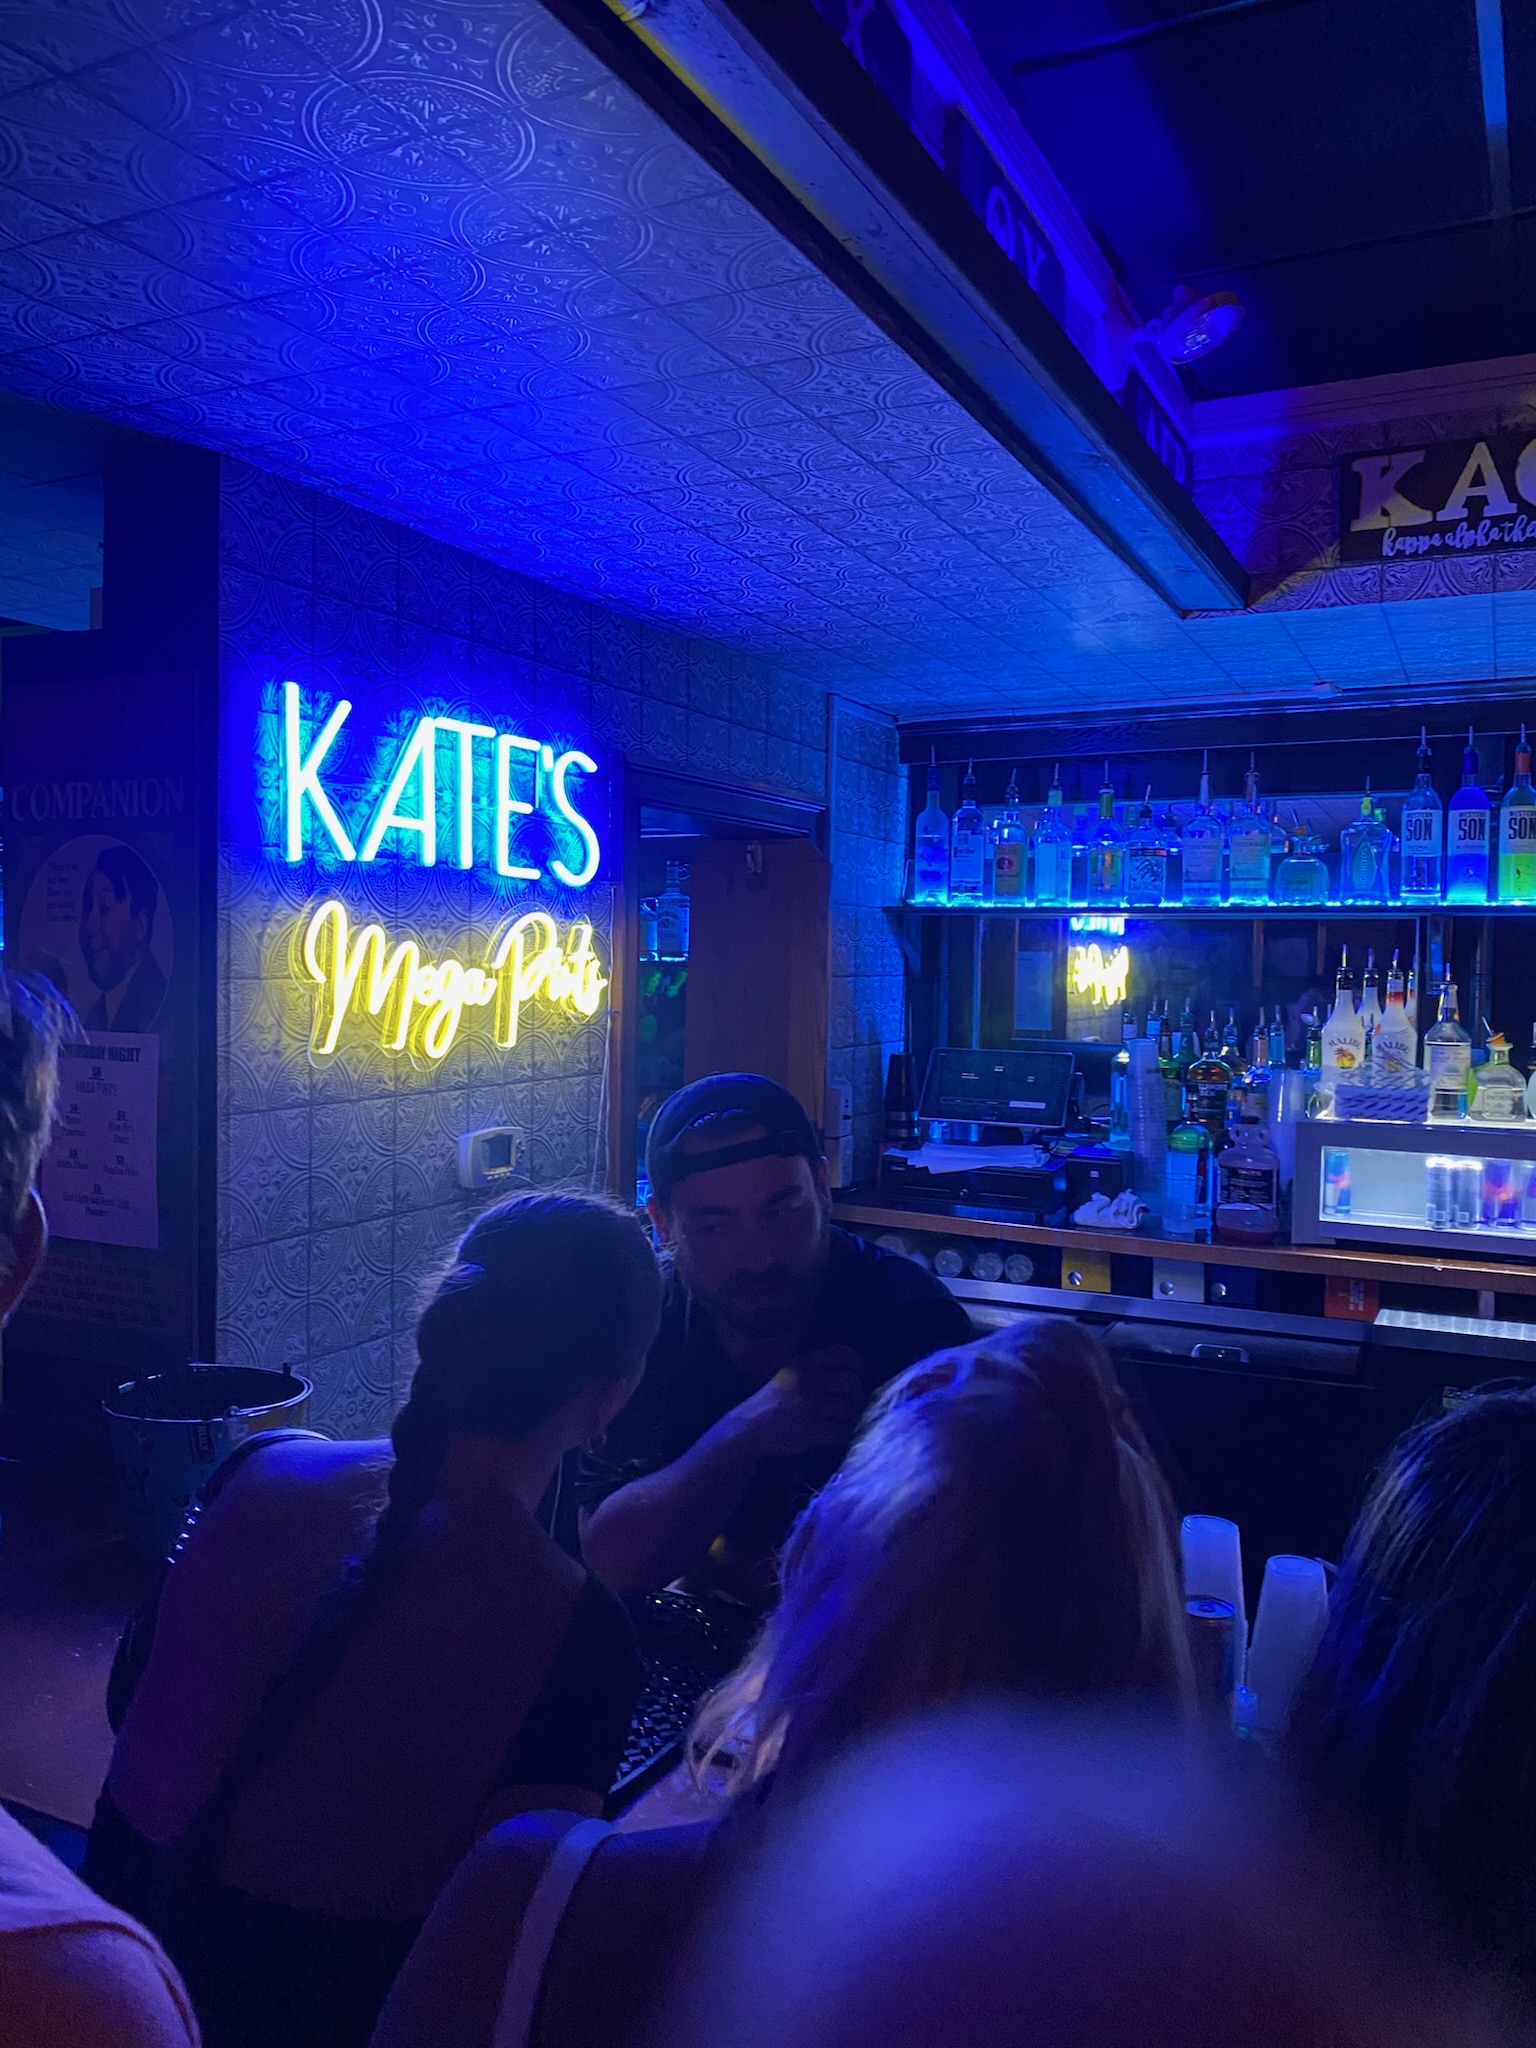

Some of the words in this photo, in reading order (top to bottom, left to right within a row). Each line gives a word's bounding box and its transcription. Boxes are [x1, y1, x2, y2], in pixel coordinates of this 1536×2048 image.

[1382, 527, 1442, 557] kappa
[1444, 519, 1502, 550] alpha
[10, 776, 184, 822] COMPANION
[282, 681, 600, 888] KATE'S
[1405, 818, 1432, 841] SON
[1458, 818, 1486, 841] SON
[1508, 817, 1536, 840] SON
[303, 899, 497, 1060] Mega
[108, 1046, 141, 1063] NIGHT
